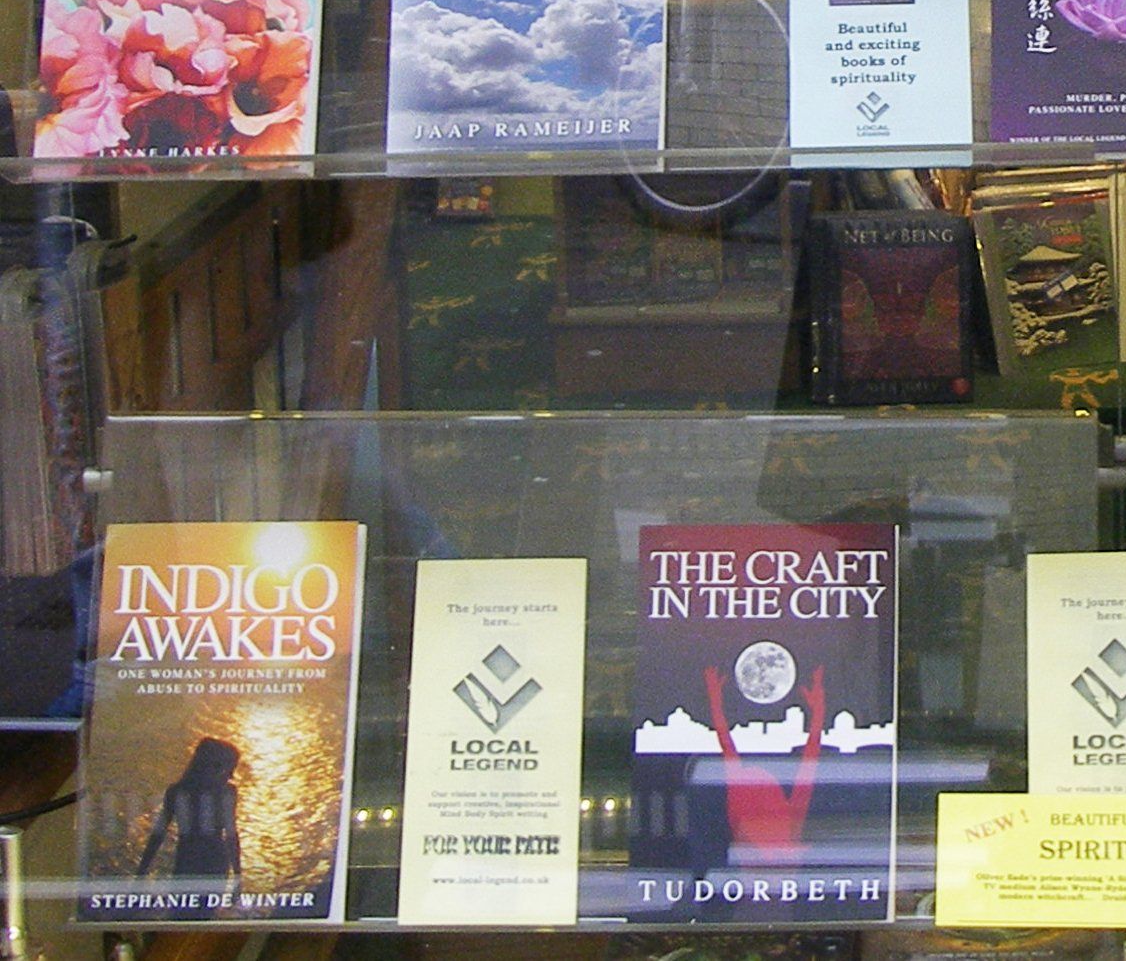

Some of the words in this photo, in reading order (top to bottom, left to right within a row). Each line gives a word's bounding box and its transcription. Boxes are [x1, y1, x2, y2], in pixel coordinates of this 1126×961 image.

[838, 22, 907, 34] Beautiful
[825, 40, 853, 51] and
[859, 39, 921, 52] exciting
[841, 56, 885, 67] books
[891, 55, 906, 66] of
[831, 72, 916, 86] spirituality
[1028, 104, 1095, 114] PASSIONATE
[414, 123, 482, 140] JAAP
[495, 119, 632, 137] RAMEIJER
[903, 229, 954, 243] BEING
[651, 551, 737, 584] THE
[745, 550, 888, 585] CRAFT
[114, 563, 339, 614] INDIGO
[473, 604, 518, 615] journey
[523, 604, 558, 612] starts
[649, 587, 692, 618] IN
[699, 587, 782, 618] THE
[789, 587, 887, 619] CITY
[110, 615, 336, 662] AWAKES
[118, 669, 145, 679] ONE
[150, 668, 216, 679] WOMAN'S
[221, 668, 283, 679] JOURNEY
[288, 668, 326, 679] FROM
[137, 684, 180, 694] ABUSE
[187, 683, 204, 694] TO
[208, 683, 305, 694] SPIRITUALITY
[451, 740, 539, 754] LOCAL
[450, 758, 538, 771] LEGEND
[964, 815, 1016, 843] NEW
[423, 835, 458, 855] FOR
[638, 879, 881, 902] TUDORBETH
[91, 894, 200, 908] STEPHANIE
[207, 893, 231, 907] DE
[240, 893, 315, 907] WINTER
